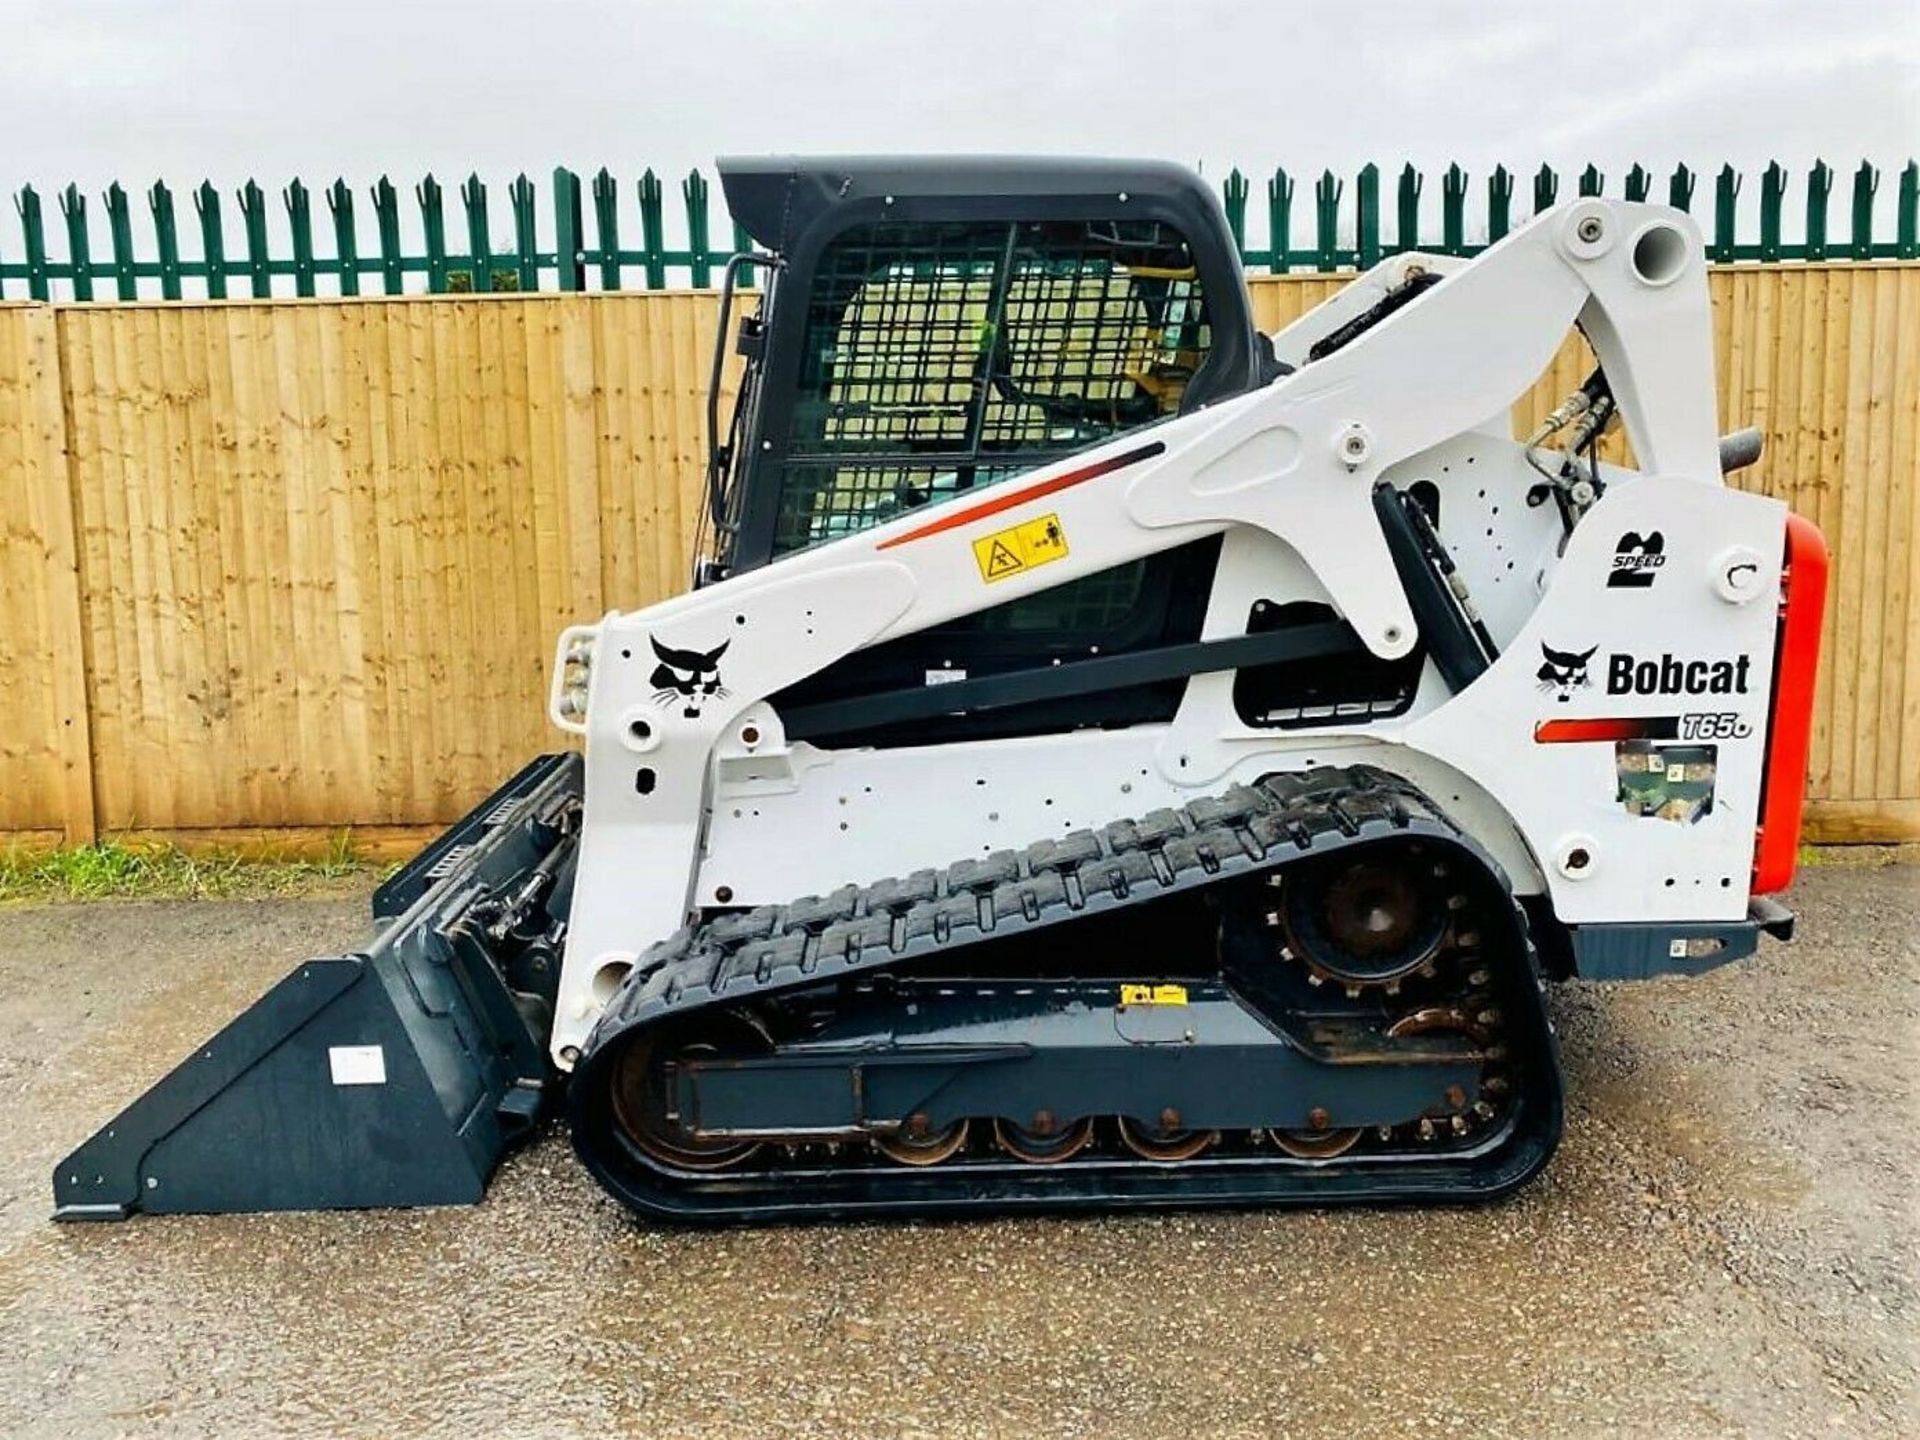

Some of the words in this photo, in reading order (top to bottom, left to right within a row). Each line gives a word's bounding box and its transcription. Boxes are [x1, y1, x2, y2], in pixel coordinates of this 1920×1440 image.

[1606, 530, 1665, 588] 2
[1612, 555, 1667, 568] SPEED
[1607, 653, 1750, 695] Bobcat
